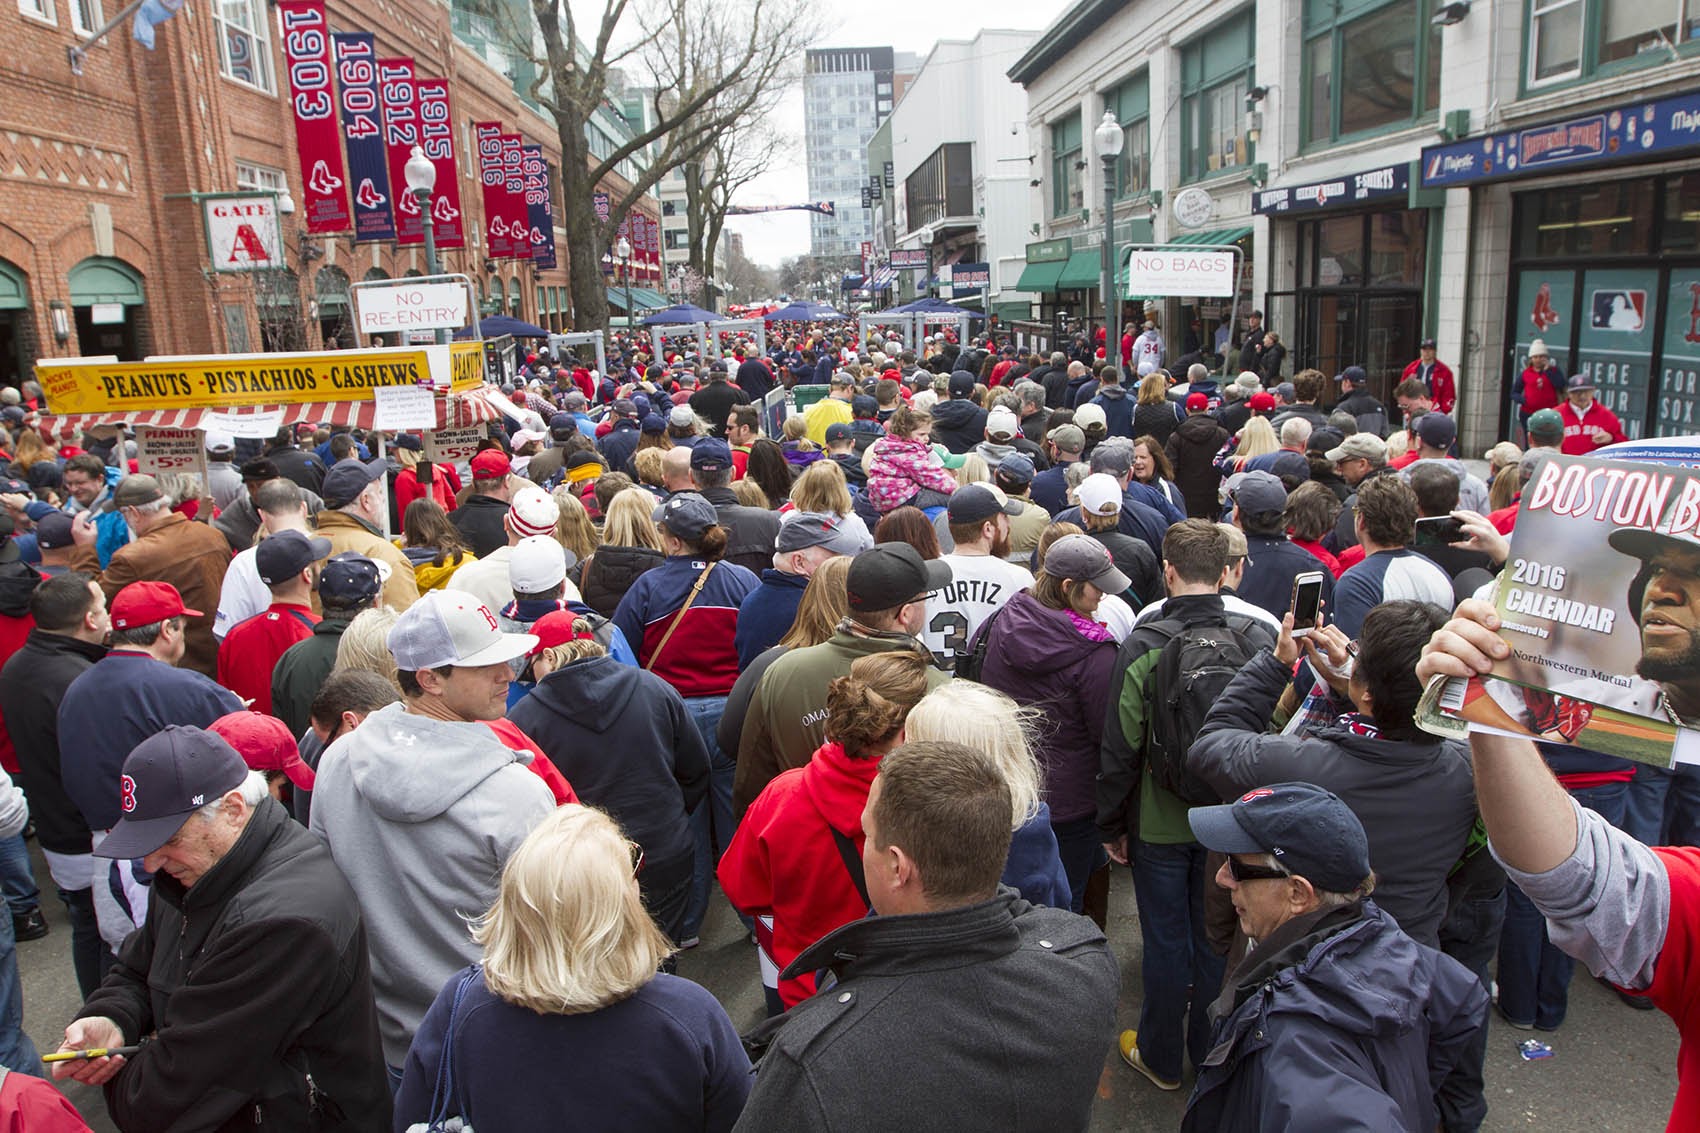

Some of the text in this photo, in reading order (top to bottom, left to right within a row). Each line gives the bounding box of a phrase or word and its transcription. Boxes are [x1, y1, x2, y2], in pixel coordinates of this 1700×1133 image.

[284, 8, 332, 121] 1903
[338, 41, 380, 139] 1904
[381, 65, 417, 146] 1912
[418, 86, 452, 160] 1915
[478, 127, 504, 187] 1916
[502, 138, 524, 195] 1918
[523, 149, 544, 205] 1946
[213, 204, 272, 218] GATE
[228, 224, 272, 262] A
[1137, 258, 1227, 272] NO BAGS
[364, 306, 459, 326] RE-ENTRY
[396, 292, 424, 306] NO
[1144, 343, 1159, 354] 34
[101, 362, 420, 399] PEANUTS PISTACHIOS CASHEWS
[452, 350, 482, 382] PEANUTS
[1582, 361, 1630, 385] HERE
[1664, 368, 1697, 394] FOR
[1660, 396, 1694, 423] SOX
[145, 430, 197, 439] PEANUTS
[1528, 460, 1675, 532] BOSTON
[1511, 558, 1566, 592] 2016
[943, 580, 1002, 605] ORTIZ
[477, 605, 498, 631] B
[1504, 587, 1617, 635] CALENDAR
[1538, 626, 1550, 639] by
[1512, 649, 1633, 689] Northwestern Mutual
